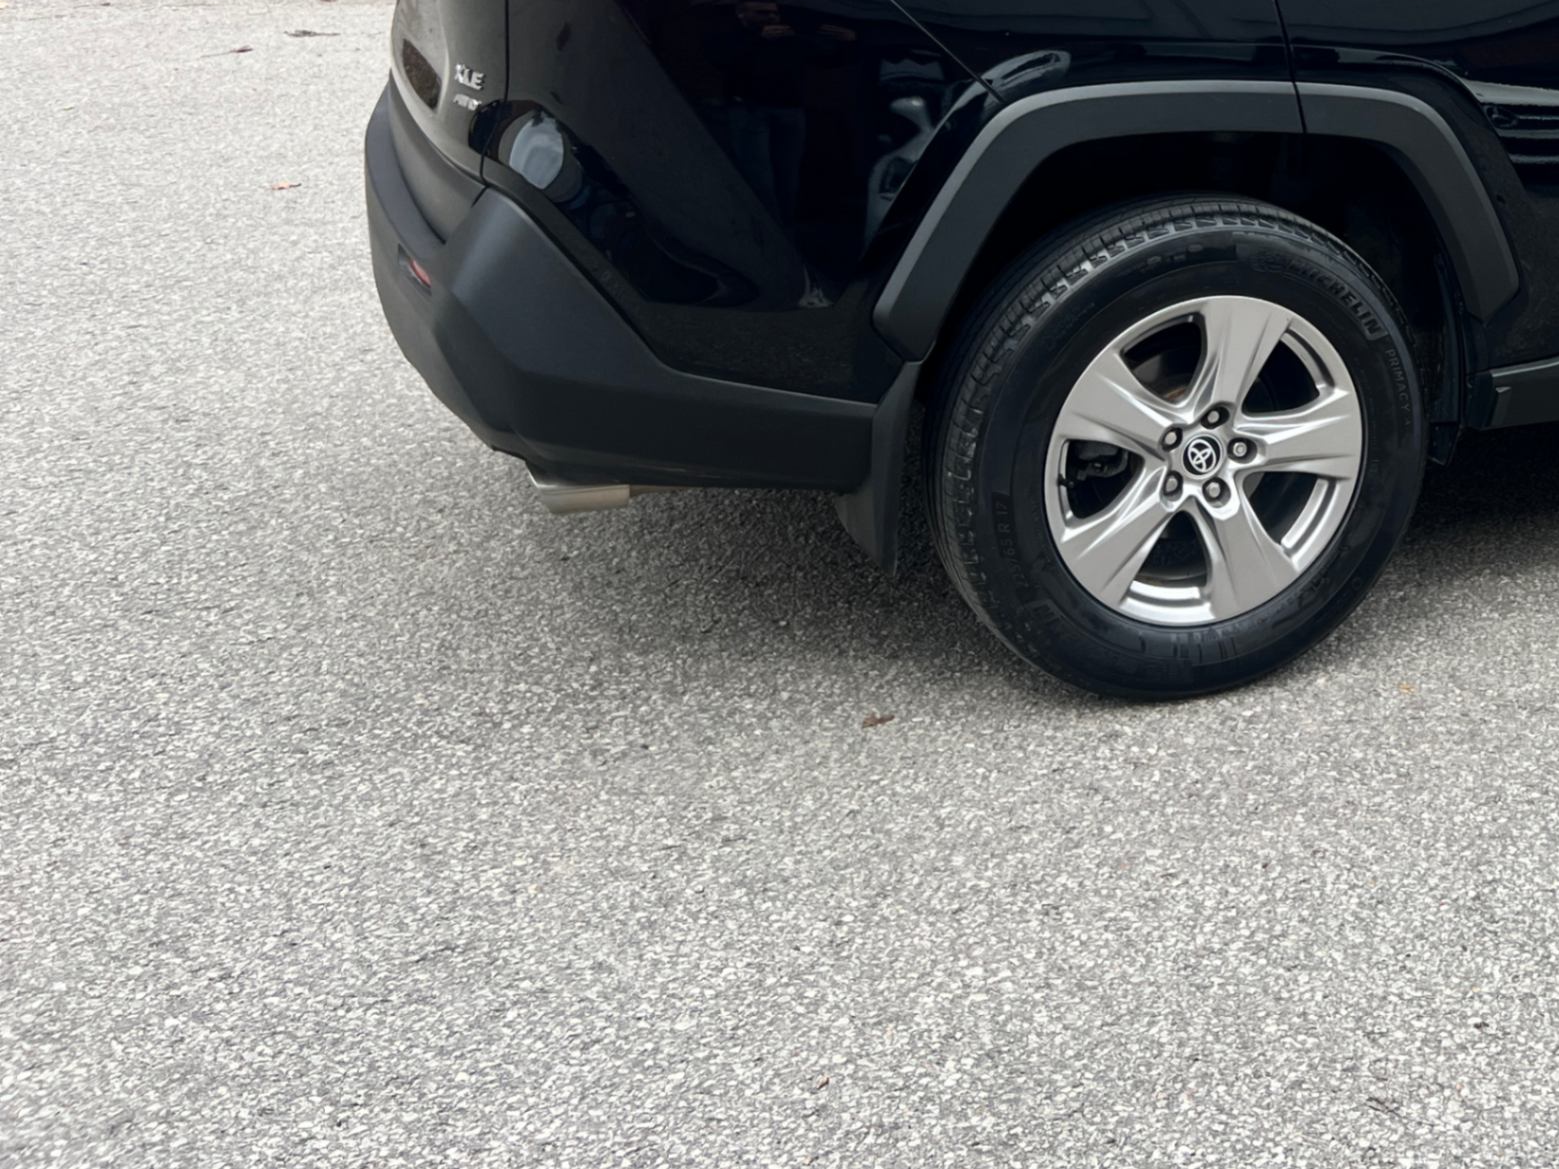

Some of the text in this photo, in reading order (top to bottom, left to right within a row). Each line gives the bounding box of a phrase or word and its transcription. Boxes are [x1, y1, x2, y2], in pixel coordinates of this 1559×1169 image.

[453, 63, 484, 90] XLE
[1284, 257, 1412, 413] MICHELIN PRIMACY
